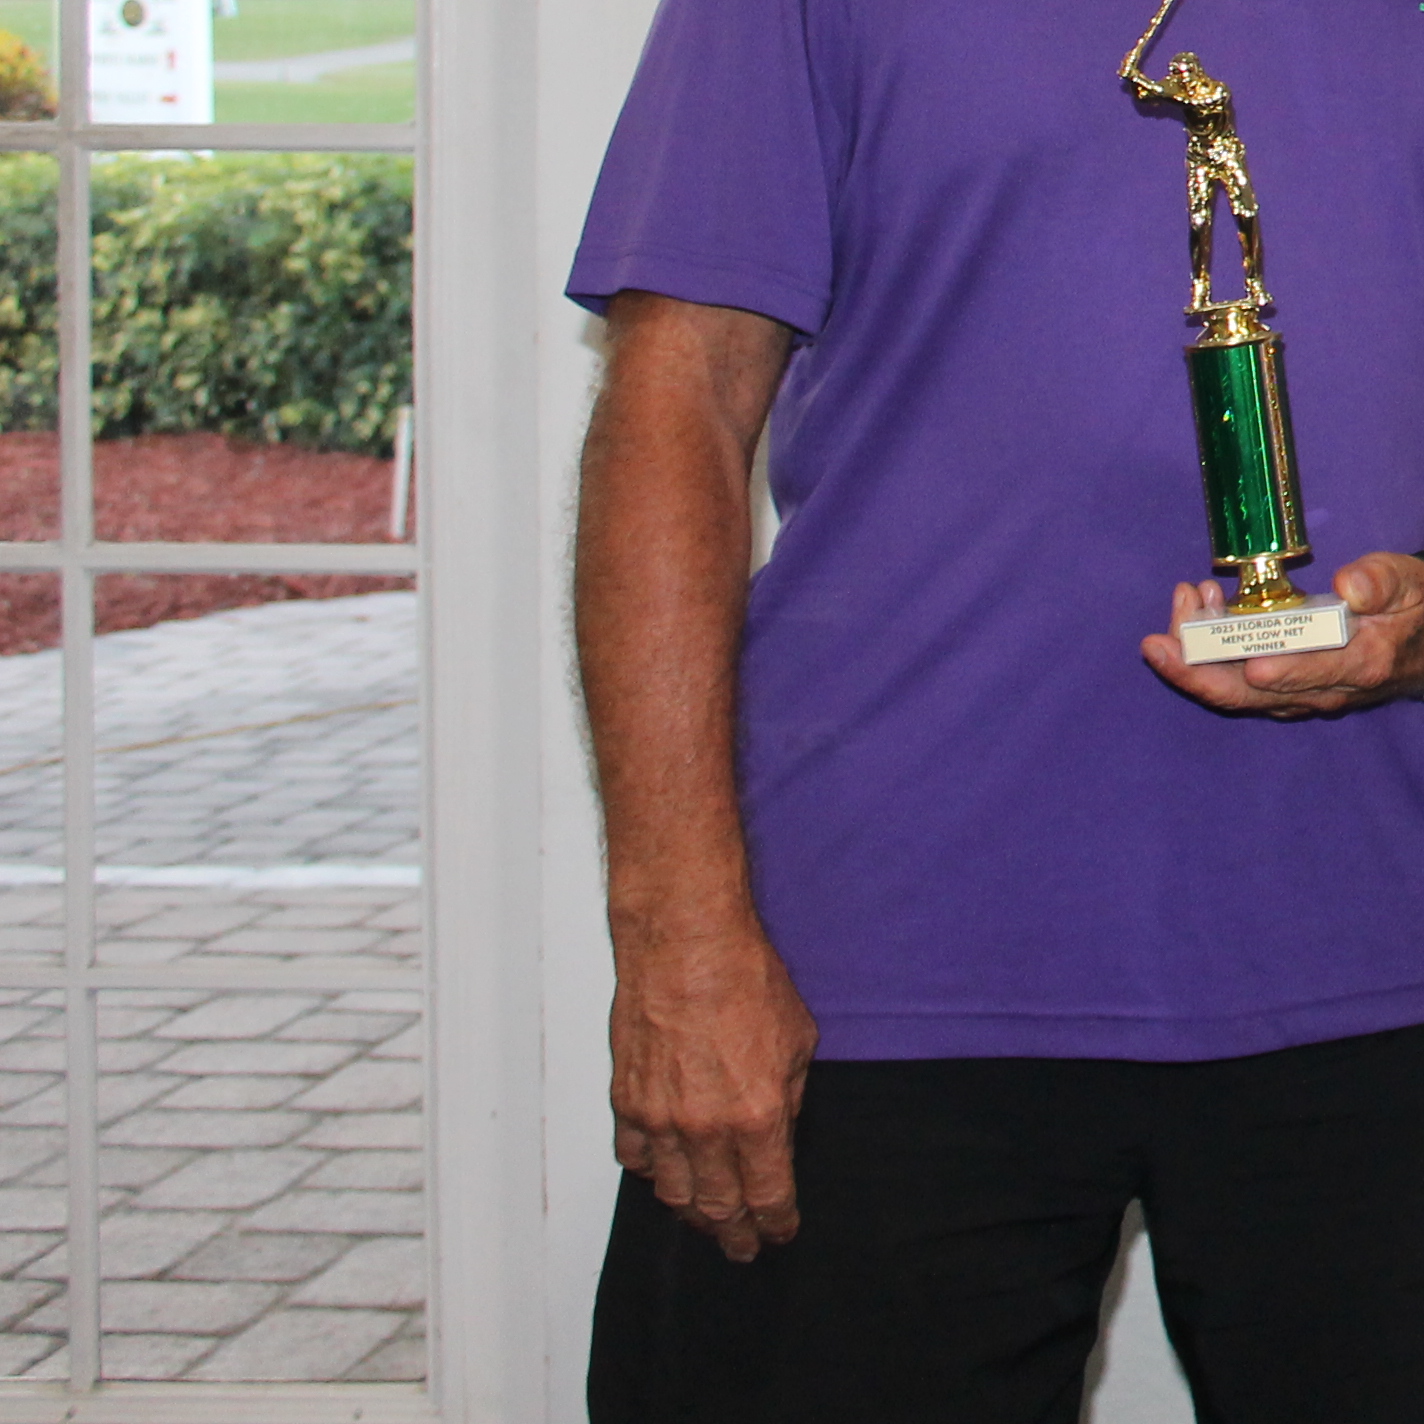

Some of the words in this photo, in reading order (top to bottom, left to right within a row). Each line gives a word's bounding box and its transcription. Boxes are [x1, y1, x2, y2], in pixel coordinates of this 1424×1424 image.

[1237, 619, 1282, 633] FLORIDA
[1284, 615, 1313, 626] OPEN
[1221, 634, 1254, 645] MEN'S
[1256, 630, 1281, 641] LOW
[1283, 627, 1305, 637] NET
[1242, 642, 1286, 653] WINNER
